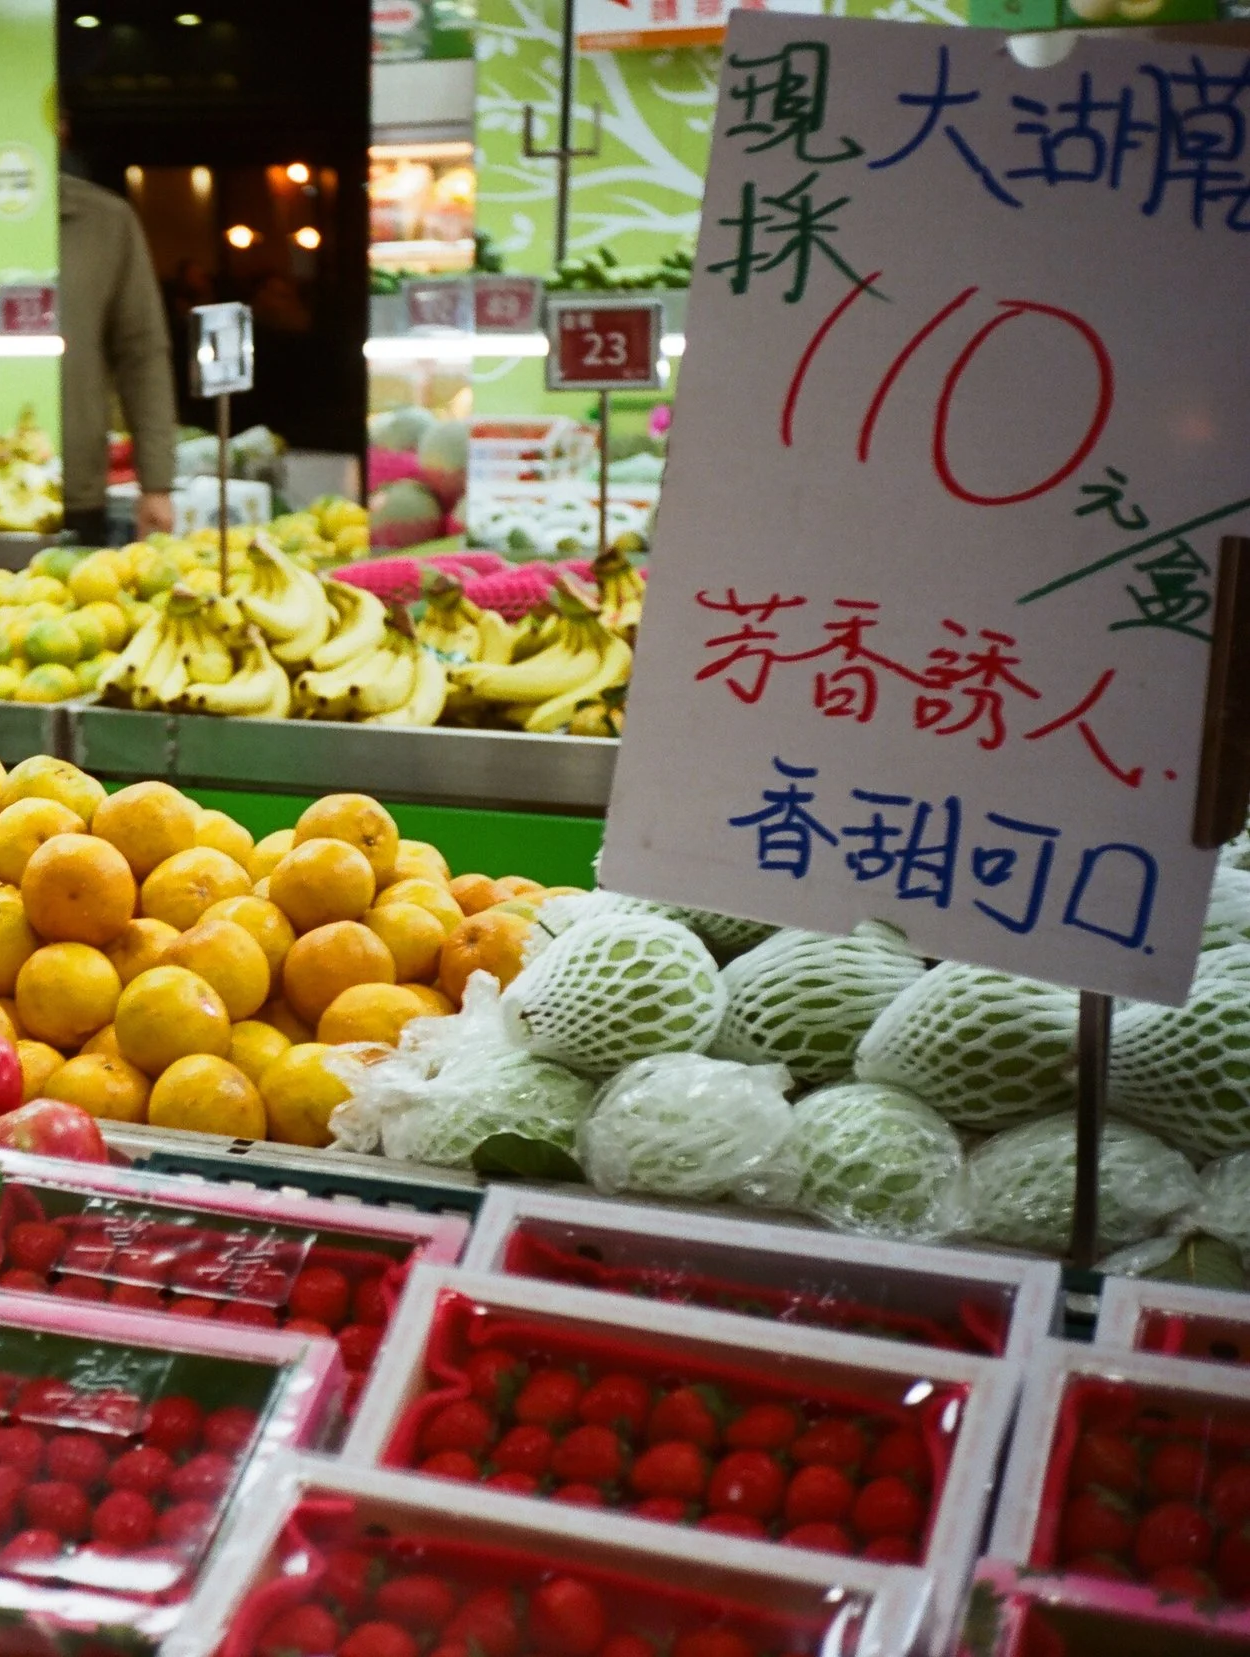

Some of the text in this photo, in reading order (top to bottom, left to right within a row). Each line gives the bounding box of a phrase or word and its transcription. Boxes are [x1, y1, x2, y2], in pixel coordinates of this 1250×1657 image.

[705, 40, 894, 303] 現採
[582, 331, 628, 367] 23
[779, 270, 1115, 507] 110
